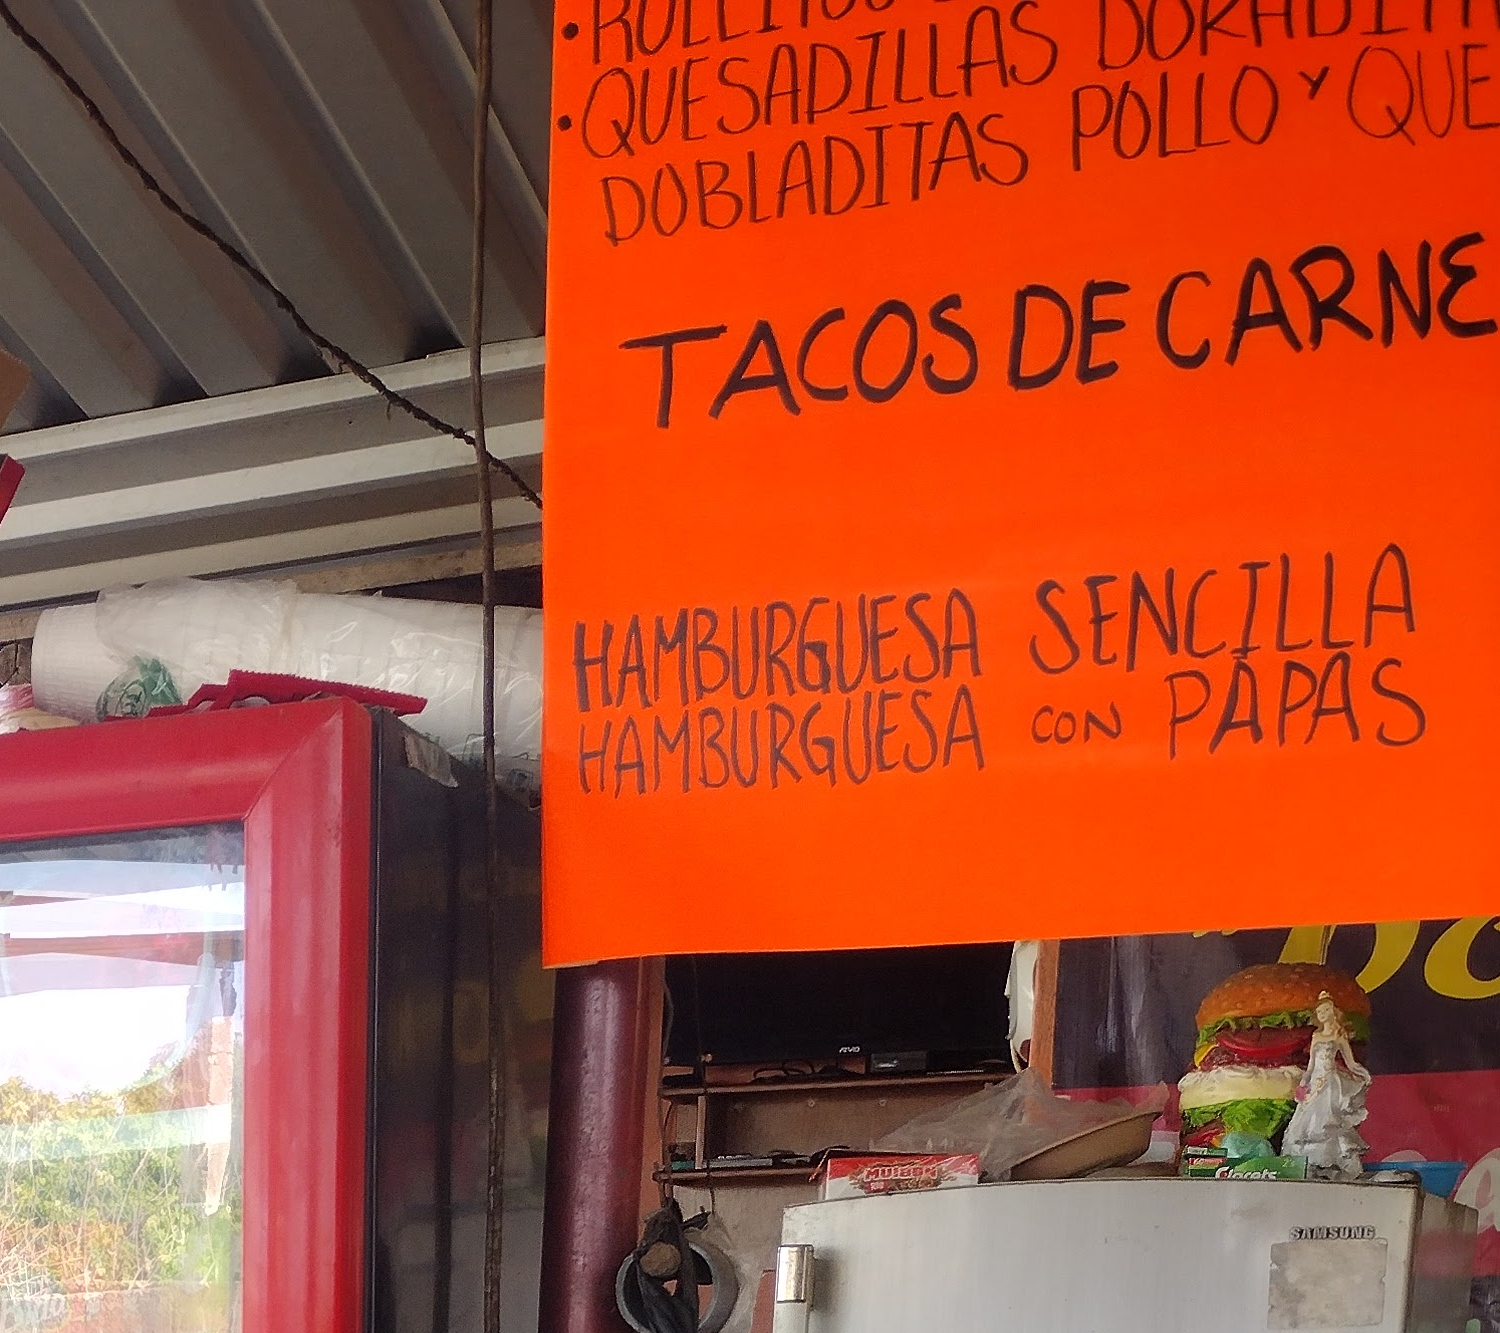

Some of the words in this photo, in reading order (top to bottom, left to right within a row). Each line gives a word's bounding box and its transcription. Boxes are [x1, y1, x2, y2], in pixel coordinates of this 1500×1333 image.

[582, 0, 1058, 159] QUESADILLAS
[600, 112, 1029, 247] DOBLADITAS
[1071, 65, 1279, 171] POLLO
[1346, 44, 1500, 145] QUE
[622, 292, 979, 430] TACOS
[1007, 280, 1130, 391] DE
[1154, 231, 1500, 370] CARNE
[572, 588, 983, 713] HAMBURGUESA
[1029, 543, 1415, 675] SENCILLA
[577, 684, 985, 798] HAMBURGUESA
[1166, 651, 1427, 760] PAPAS
[1290, 1225, 1375, 1241] SAMSUNG
